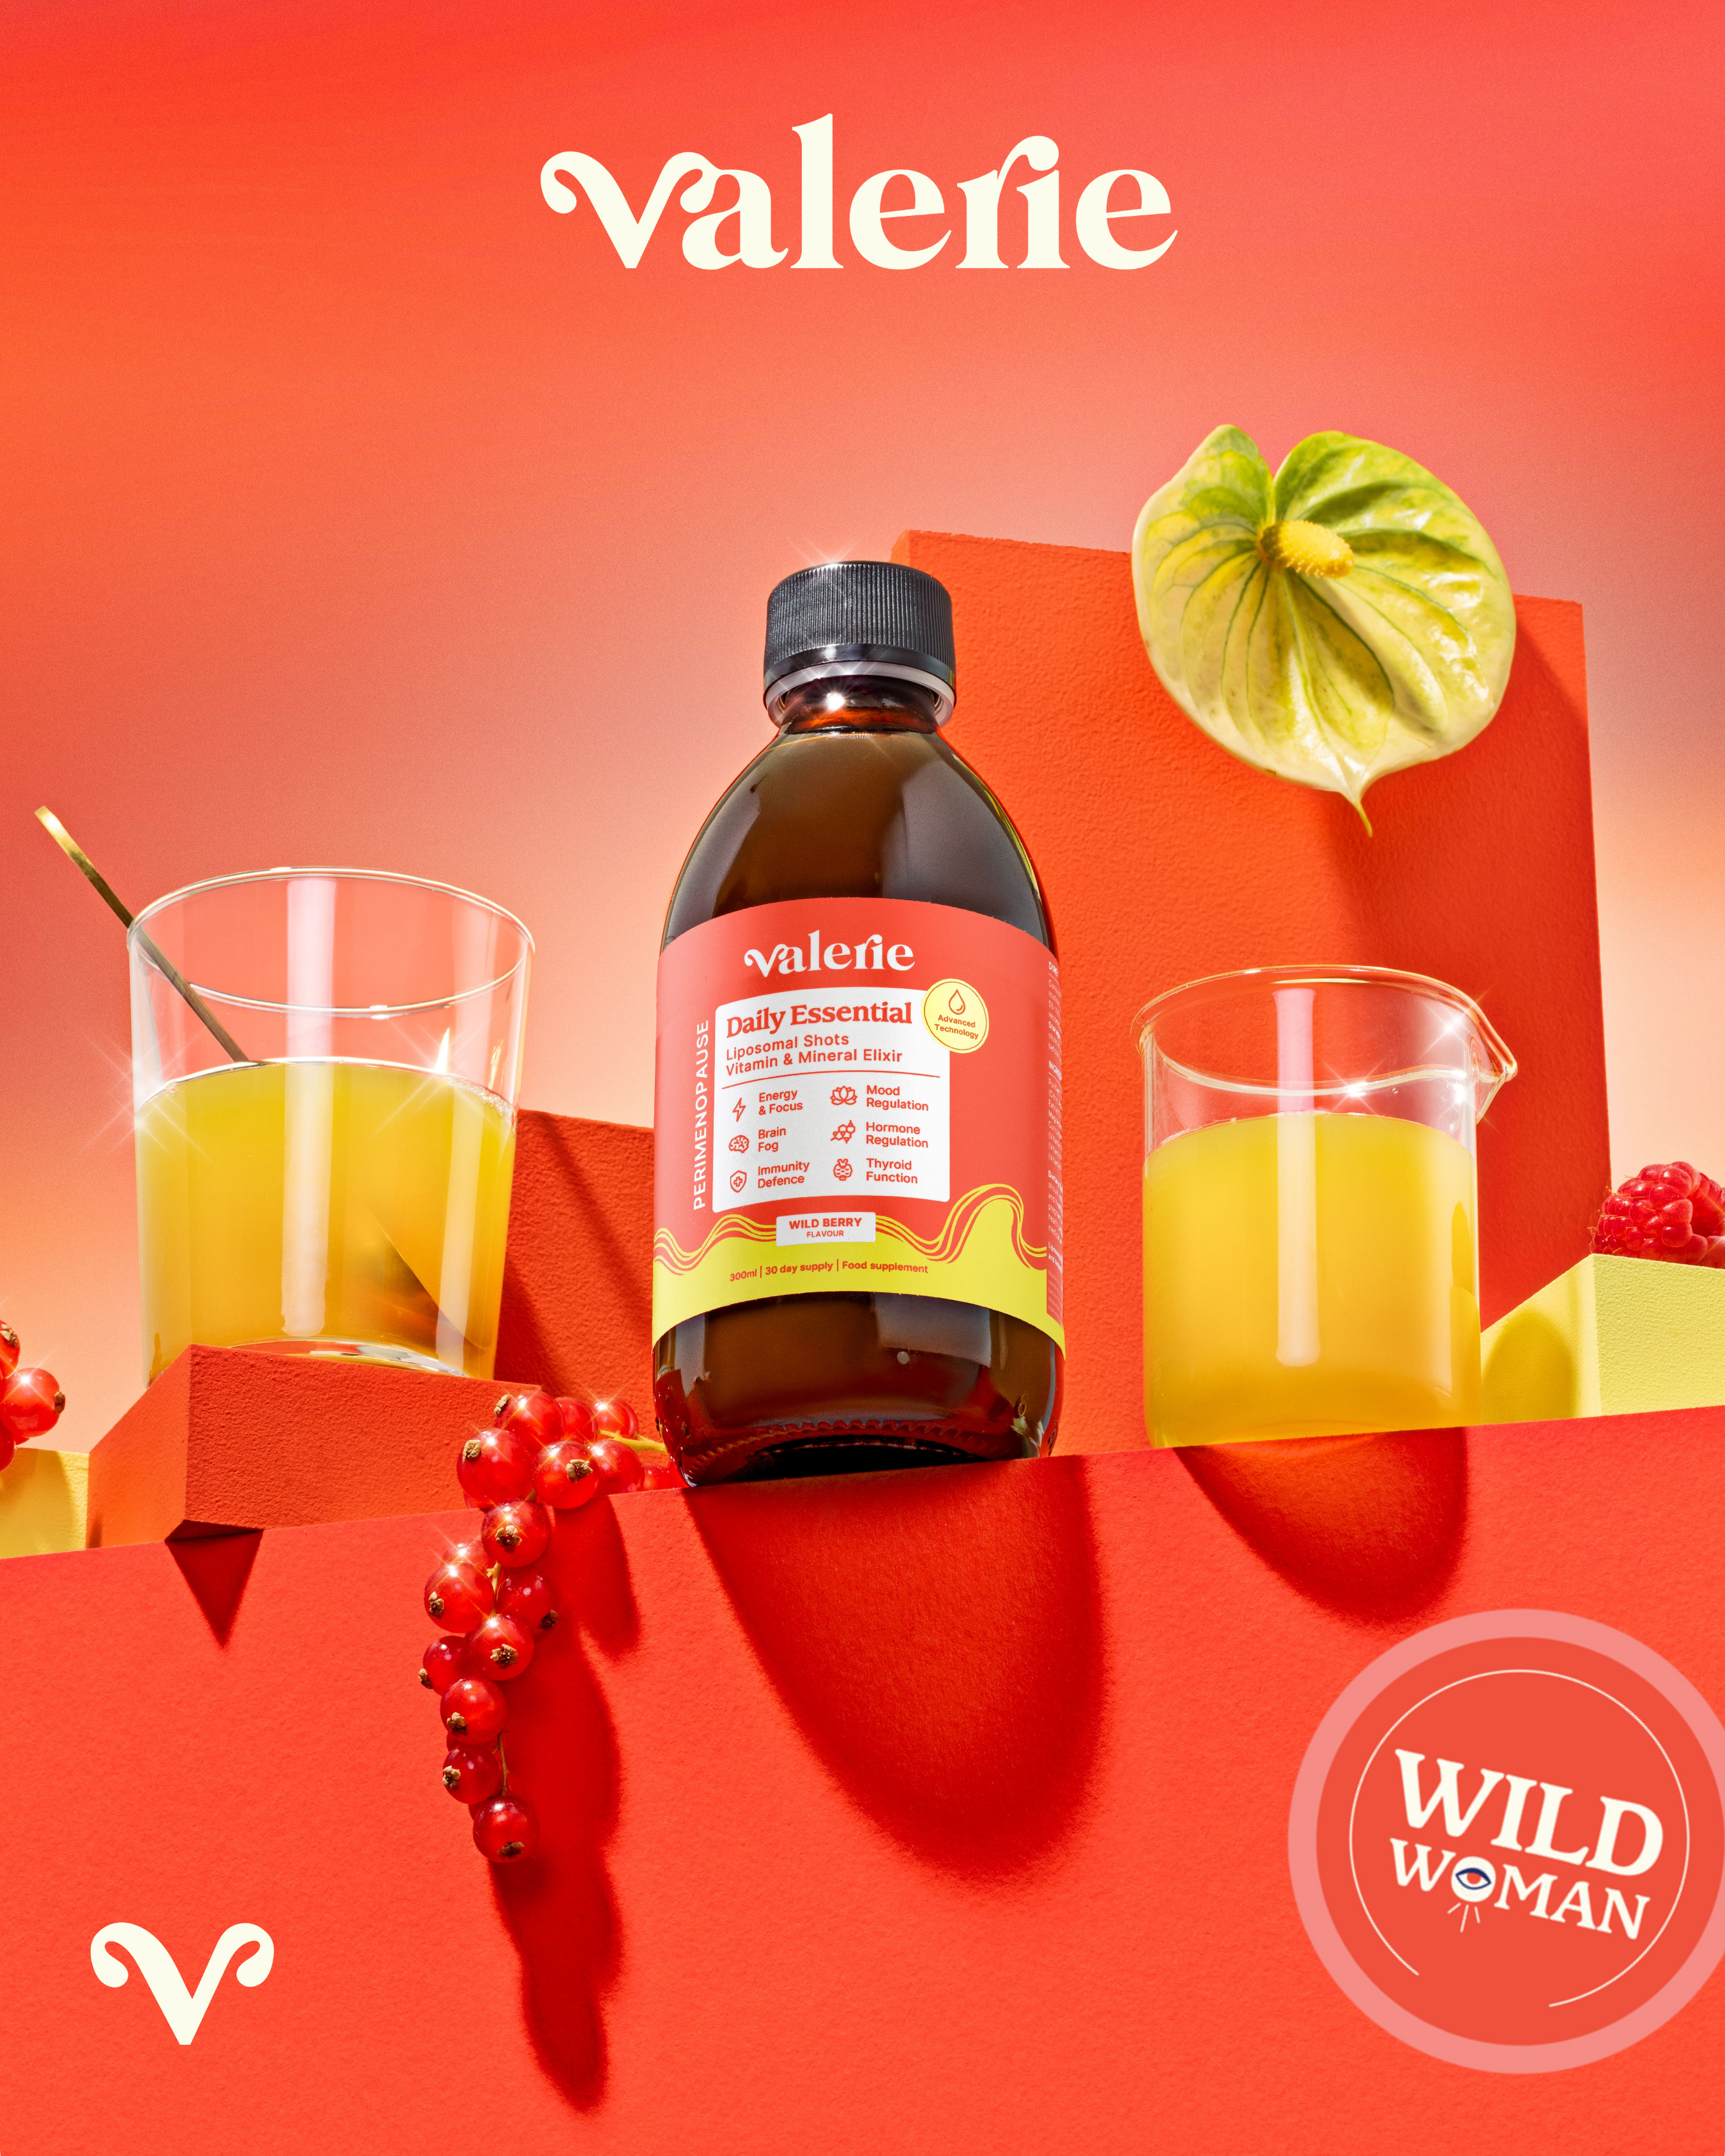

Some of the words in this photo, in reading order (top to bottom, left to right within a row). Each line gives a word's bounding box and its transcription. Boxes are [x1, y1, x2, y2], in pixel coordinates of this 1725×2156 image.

[727, 1007, 786, 1037] Daily
[790, 1002, 912, 1025] Essential
[938, 1014, 976, 1027] Advanced
[934, 1024, 979, 1039] Technology
[726, 1036, 798, 1061] Liposomal
[804, 1034, 848, 1047] Shots
[726, 1055, 778, 1076] Vitamin
[783, 1053, 793, 1065] &
[799, 1049, 857, 1063] Mineral
[864, 1049, 902, 1062] Elixir
[759, 1090, 798, 1103] Energy
[867, 1085, 900, 1096] Mood
[759, 1106, 766, 1115] &
[769, 1103, 802, 1113] Focus
[867, 1097, 928, 1111] Regulation
[694, 1020, 709, 1210] PERIMENOPAUSE
[758, 1127, 786, 1138] Brain
[866, 1122, 921, 1135] Hormone
[758, 1142, 778, 1152] Fog
[866, 1135, 928, 1148] Regulation
[758, 1161, 809, 1176] Immunity
[866, 1158, 912, 1172] Thyroid
[758, 1176, 804, 1188] Defence
[866, 1172, 917, 1183] Function
[789, 1219, 819, 1229] WILD
[823, 1218, 862, 1227] BERRY
[730, 1269, 757, 1281] 300ml
[765, 1266, 777, 1275] 30
[779, 1265, 797, 1274] day
[800, 1262, 833, 1272] supply
[843, 1261, 867, 1269] Food
[870, 1262, 928, 1273] supplement
